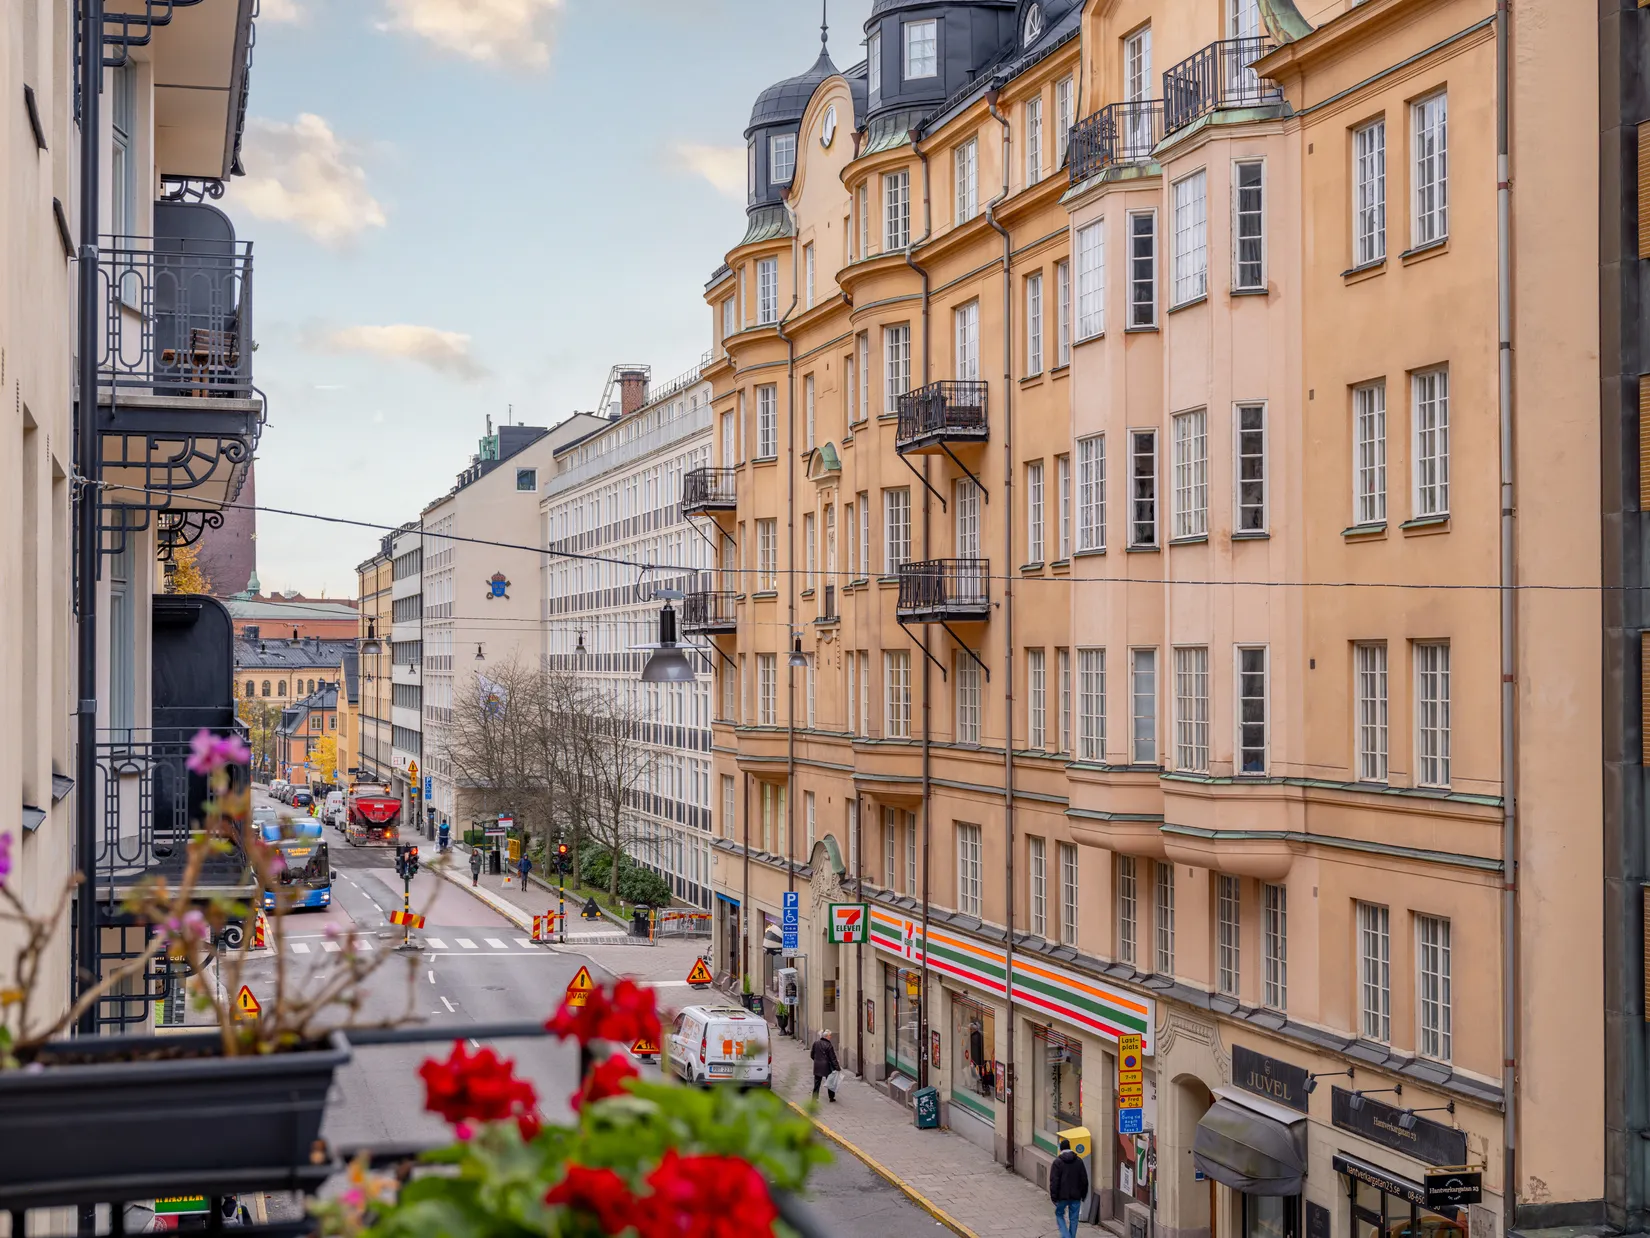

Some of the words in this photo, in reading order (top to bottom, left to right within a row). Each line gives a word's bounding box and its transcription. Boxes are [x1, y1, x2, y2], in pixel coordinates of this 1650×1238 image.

[787, 894, 796, 906] P
[837, 909, 861, 942] 7
[1121, 1043, 1139, 1051] plats
[1247, 1070, 1292, 1101] JUVEL
[1346, 1163, 1401, 1195] hantverkargatan23.se
[1428, 1186, 1473, 1194] Hantverkargatan
